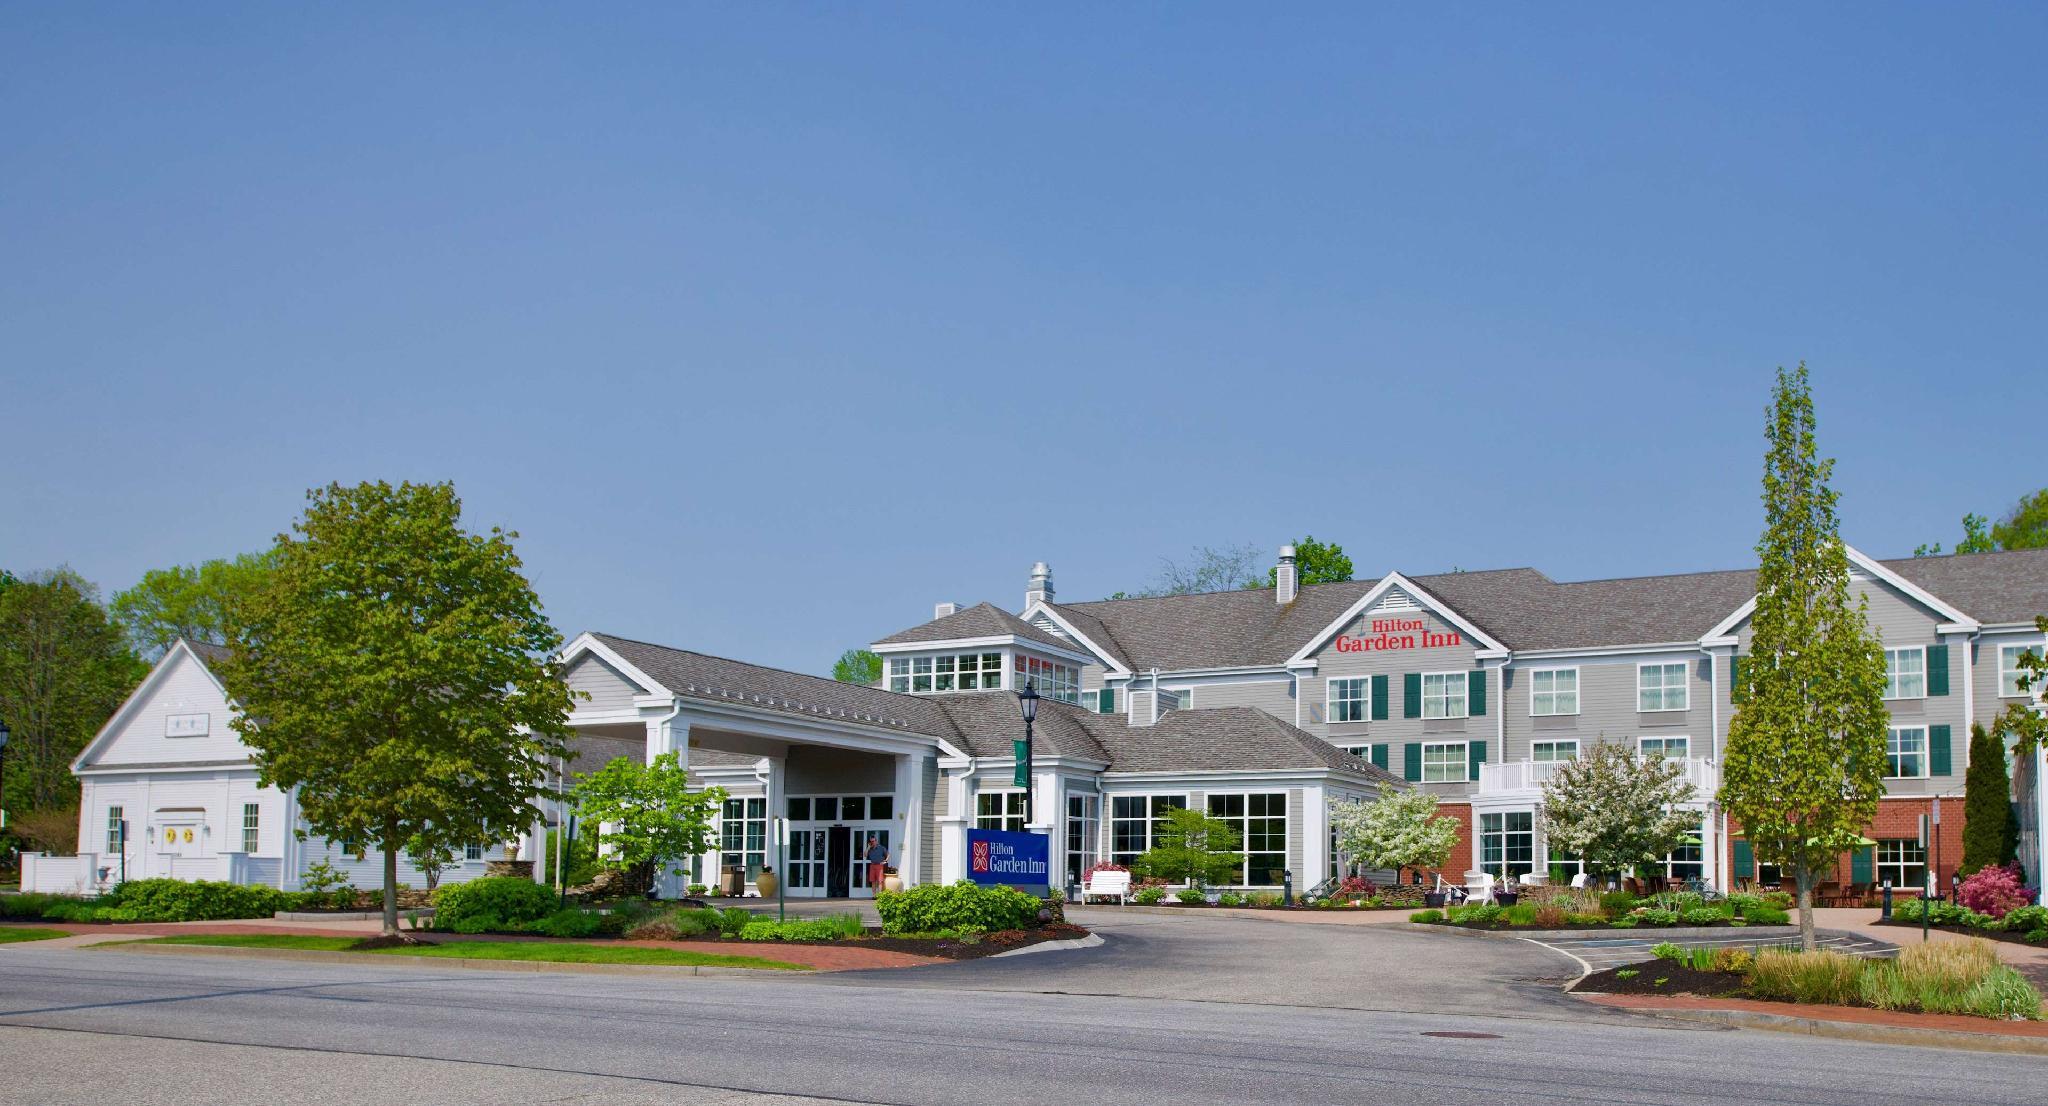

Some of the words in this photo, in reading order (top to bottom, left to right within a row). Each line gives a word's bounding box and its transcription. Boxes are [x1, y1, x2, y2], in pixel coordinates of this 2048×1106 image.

[1372, 619, 1423, 633] Hilton
[1336, 634, 1414, 652] Garden
[1421, 631, 1461, 647] Inn
[990, 842, 1013, 855] Hilton
[989, 855, 1027, 873] Garden
[1028, 857, 1046, 873] Inn
